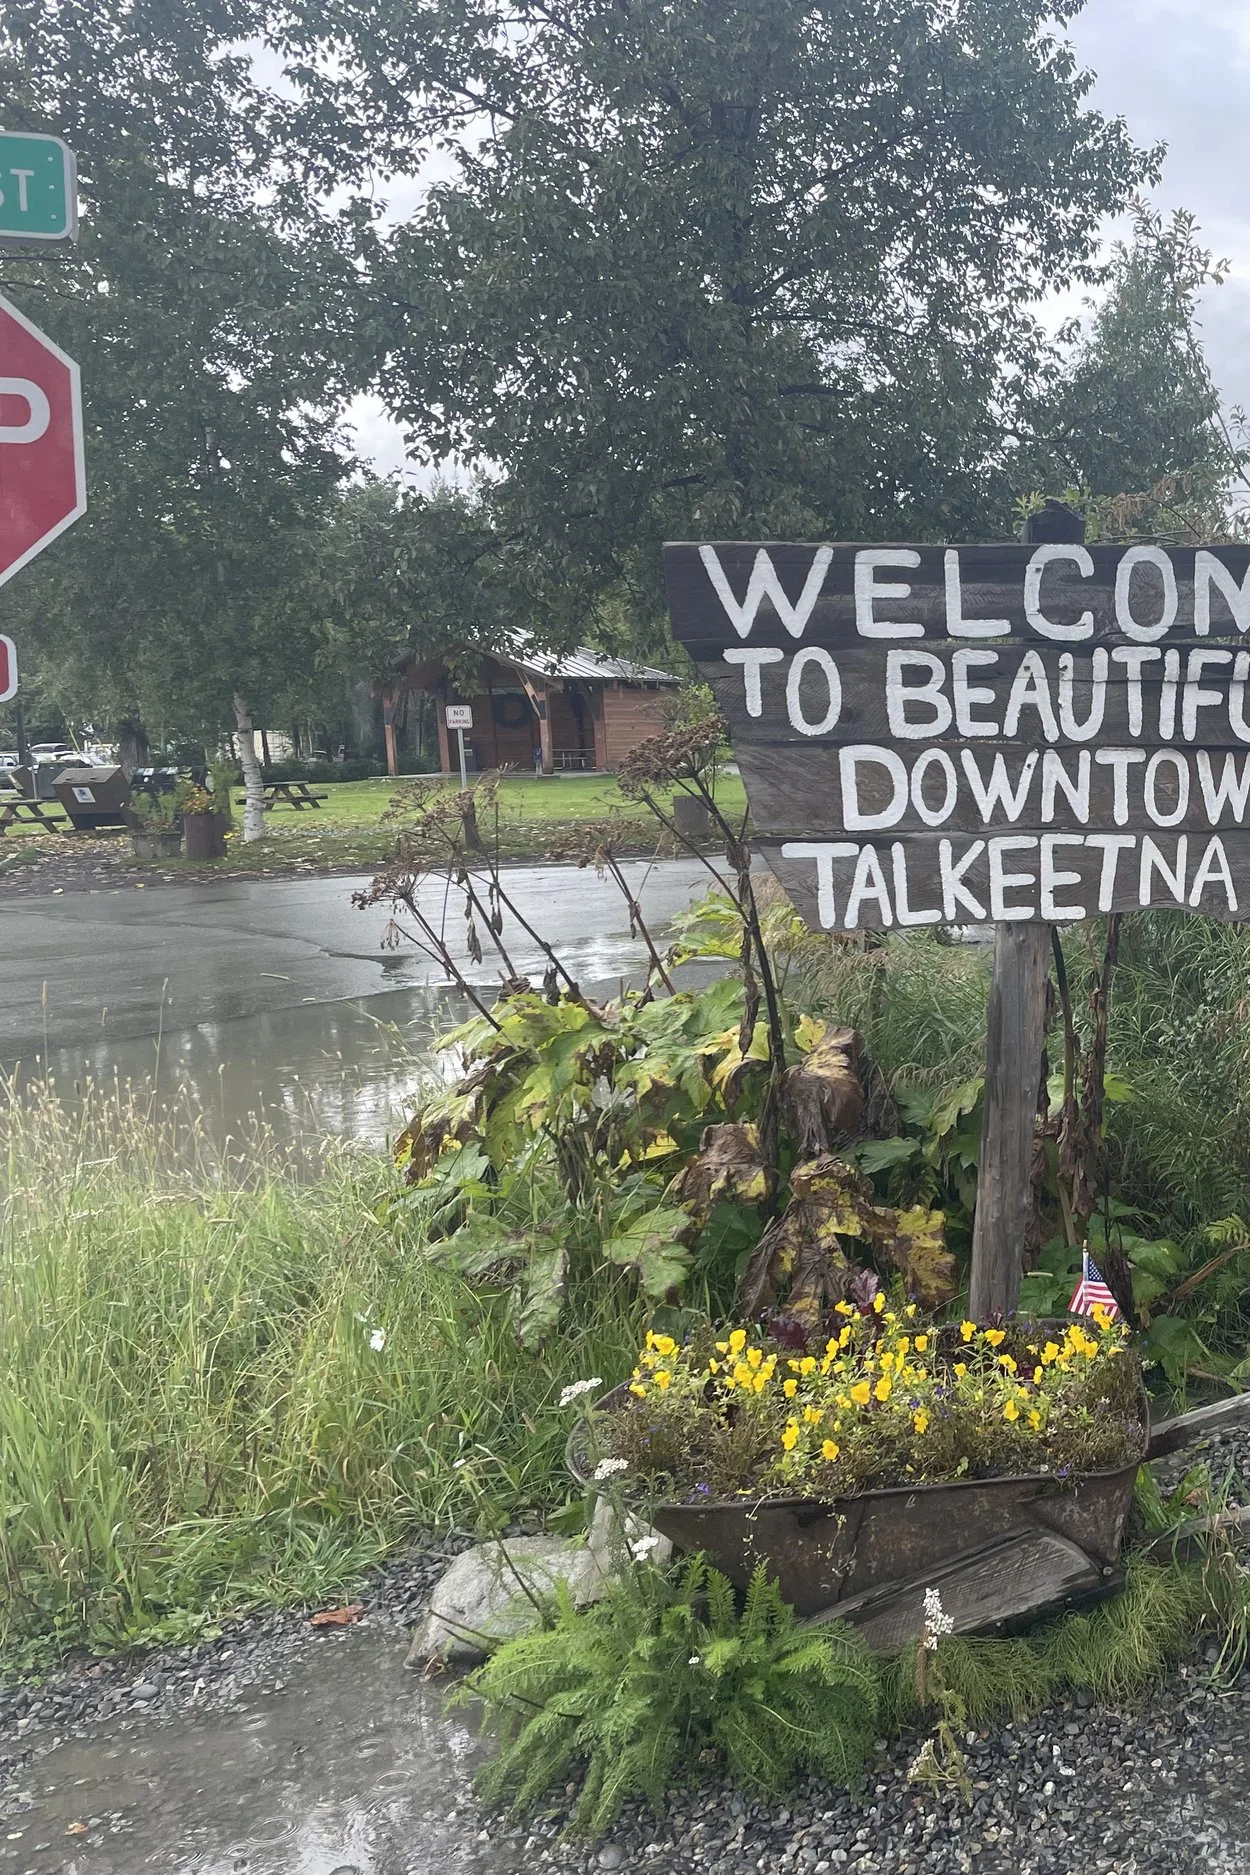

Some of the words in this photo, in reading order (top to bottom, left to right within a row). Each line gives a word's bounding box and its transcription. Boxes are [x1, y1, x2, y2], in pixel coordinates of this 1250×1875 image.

[0, 167, 35, 212] T
[722, 647, 842, 737] TO
[781, 834, 1239, 930] TALKEETNA
